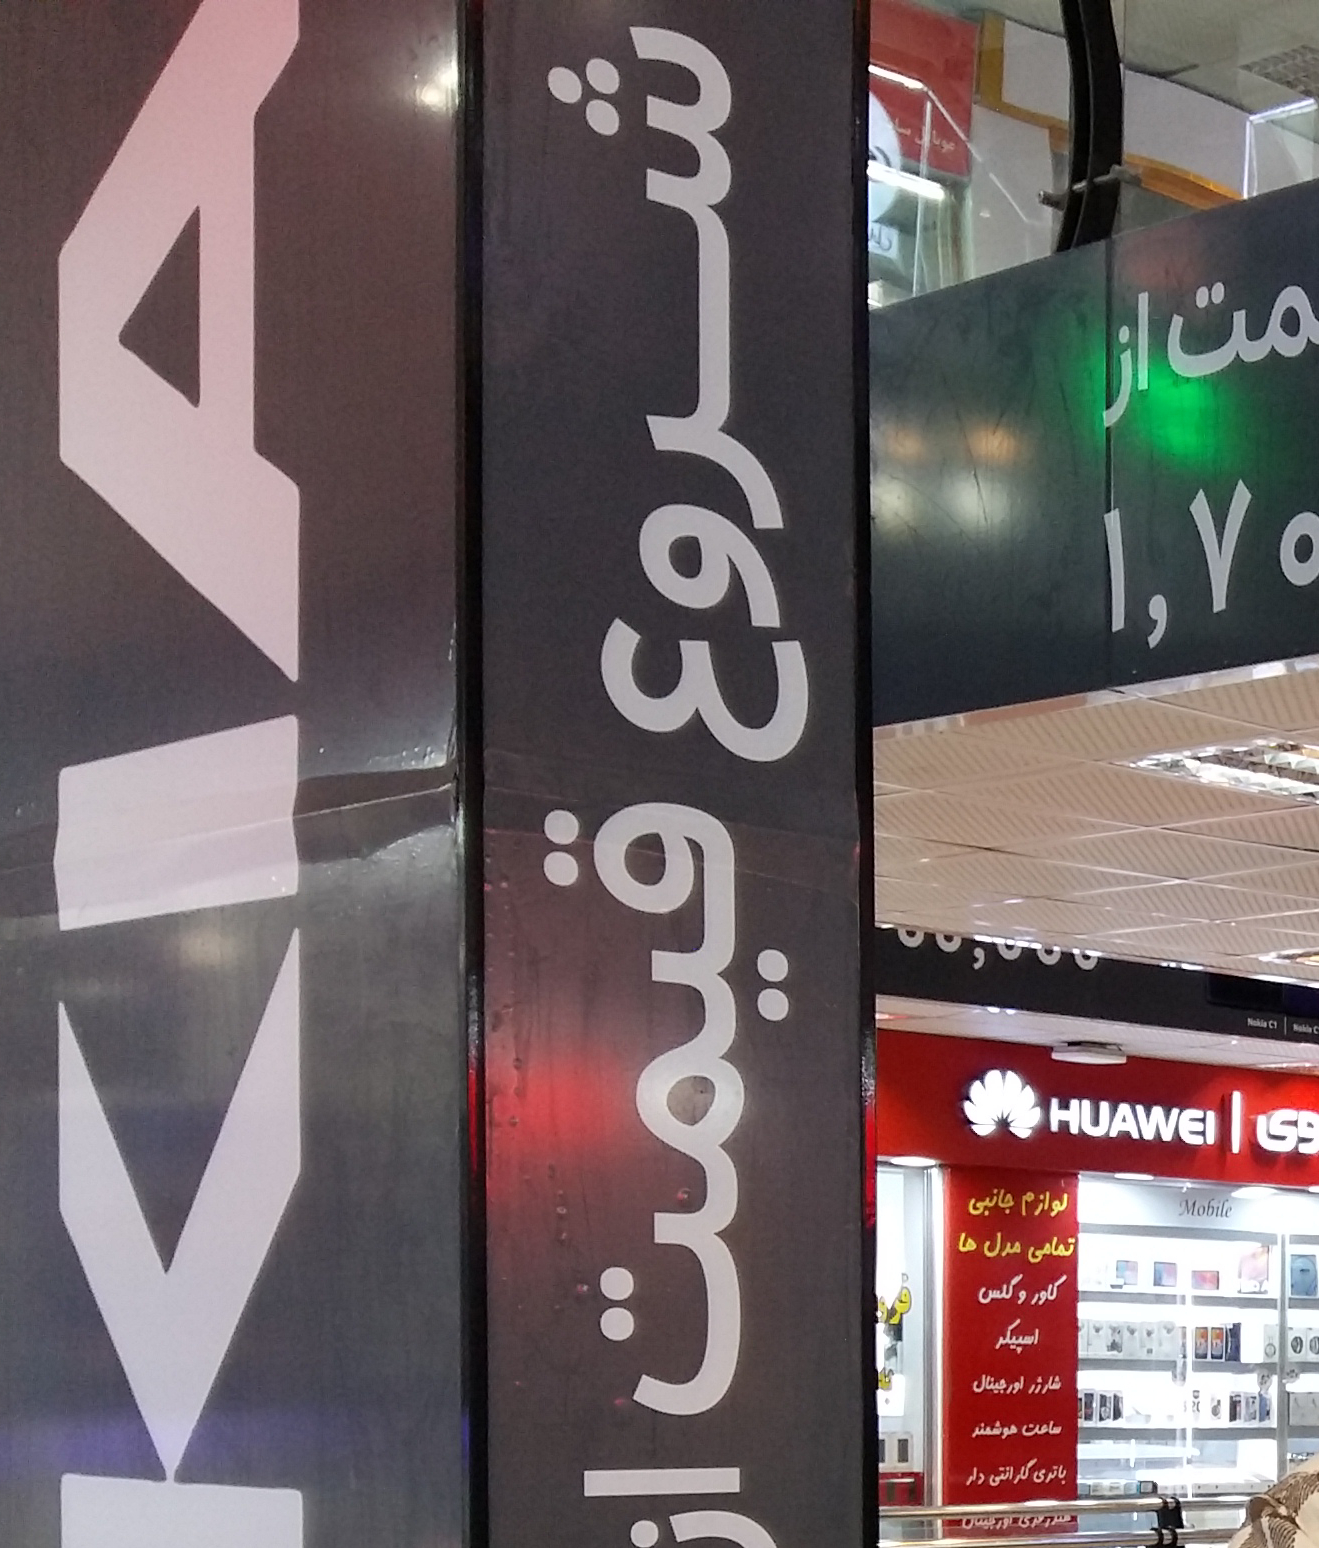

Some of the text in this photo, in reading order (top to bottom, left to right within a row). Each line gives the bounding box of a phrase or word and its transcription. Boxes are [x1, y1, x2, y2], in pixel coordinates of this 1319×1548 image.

[1102, 292, 1150, 428] از
[546, 26, 809, 763] شروع
[1247, 1017, 1278, 1029] Nokia C1
[1293, 1022, 1312, 1034] Nokia
[542, 802, 791, 1416] قیمت
[1050, 1097, 1215, 1146] HUAWEI
[968, 1188, 1068, 1218] لوازم جانبی
[1178, 1198, 1233, 1218] Mobile
[958, 1232, 1076, 1263] تمامی مدل ها
[1017, 1289, 1027, 1305] و
[1030, 1274, 1067, 1305] کاور
[995, 1318, 1039, 1354] اسپیکر
[972, 1374, 1062, 1395] شارژر اورجینال
[971, 1420, 1062, 1439] ساعت هوشمند
[965, 1458, 1067, 1487] باتری گارانتی دار
